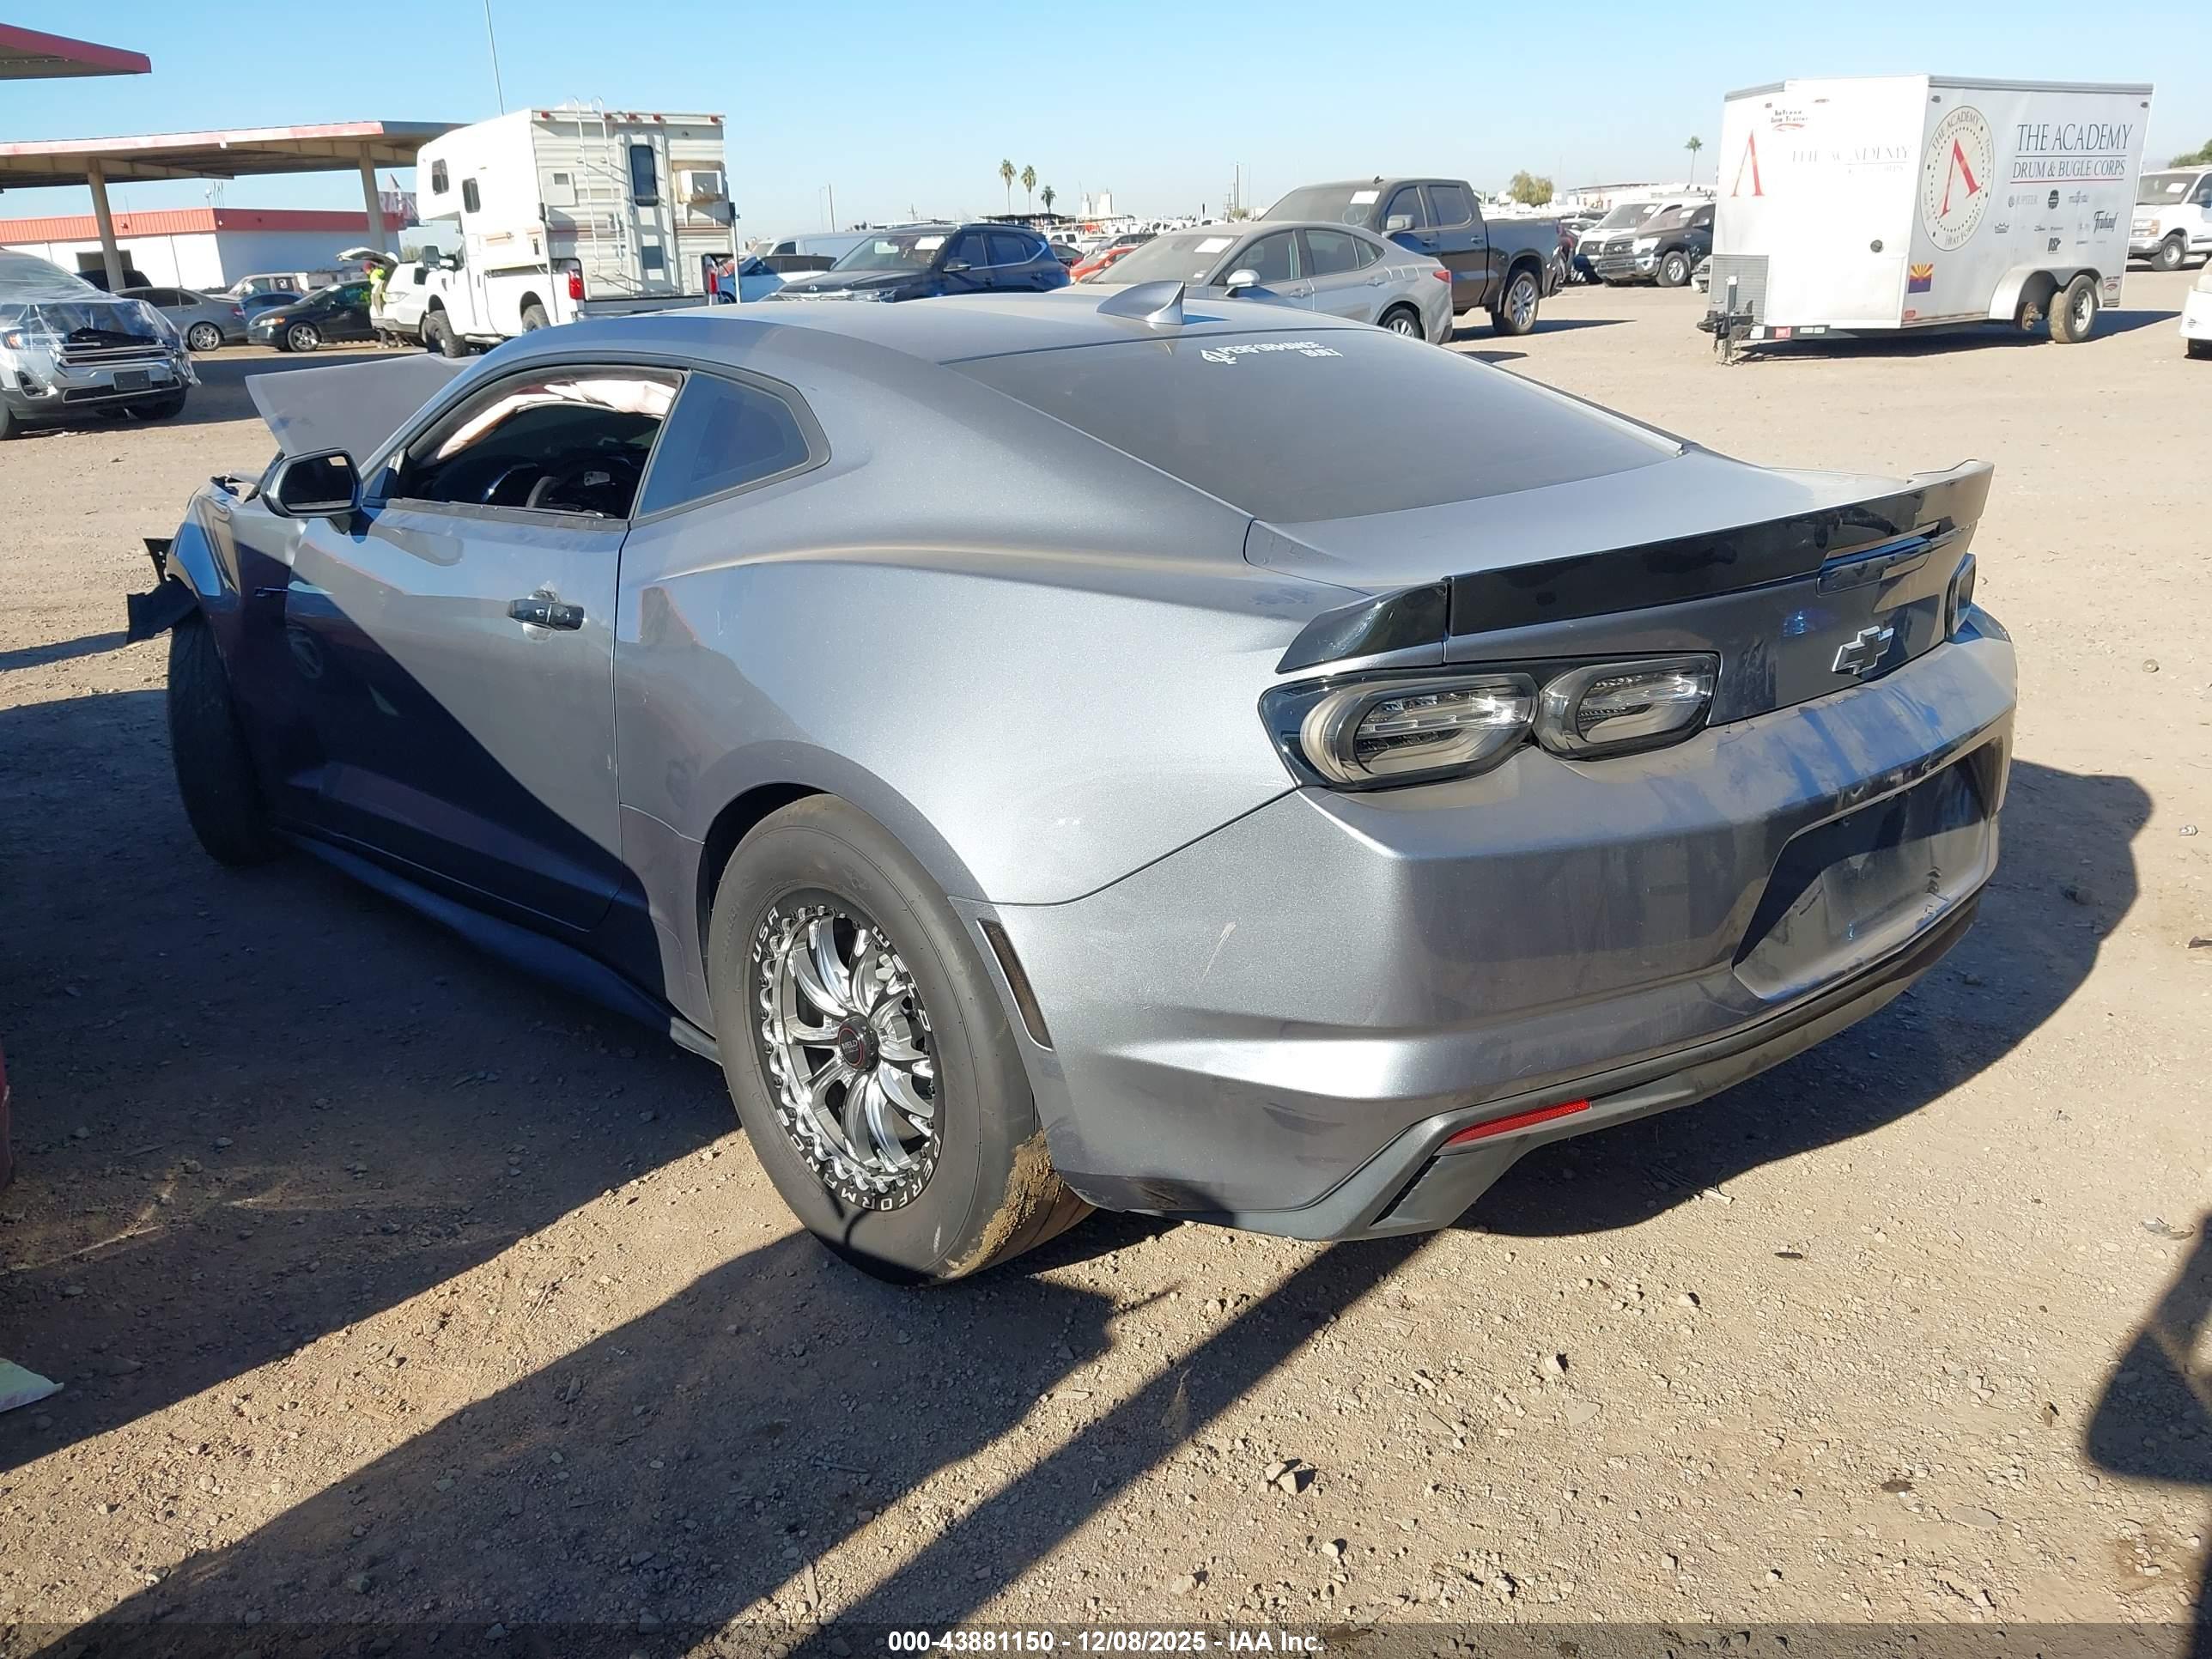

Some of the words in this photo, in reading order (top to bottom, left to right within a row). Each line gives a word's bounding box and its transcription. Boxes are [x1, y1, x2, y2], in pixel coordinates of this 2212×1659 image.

[2017, 124, 2050, 152] THE
[2051, 122, 2134, 152] ACADEMY
[2012, 161, 2046, 179] DRUM
[2047, 161, 2057, 178] &
[2057, 160, 2094, 178] BUGLE
[2094, 159, 2127, 176] CORPS
[752, 906, 780, 963] USA
[872, 925, 932, 1032] WELD
[776, 1108, 943, 1212] PERFORMANCE
